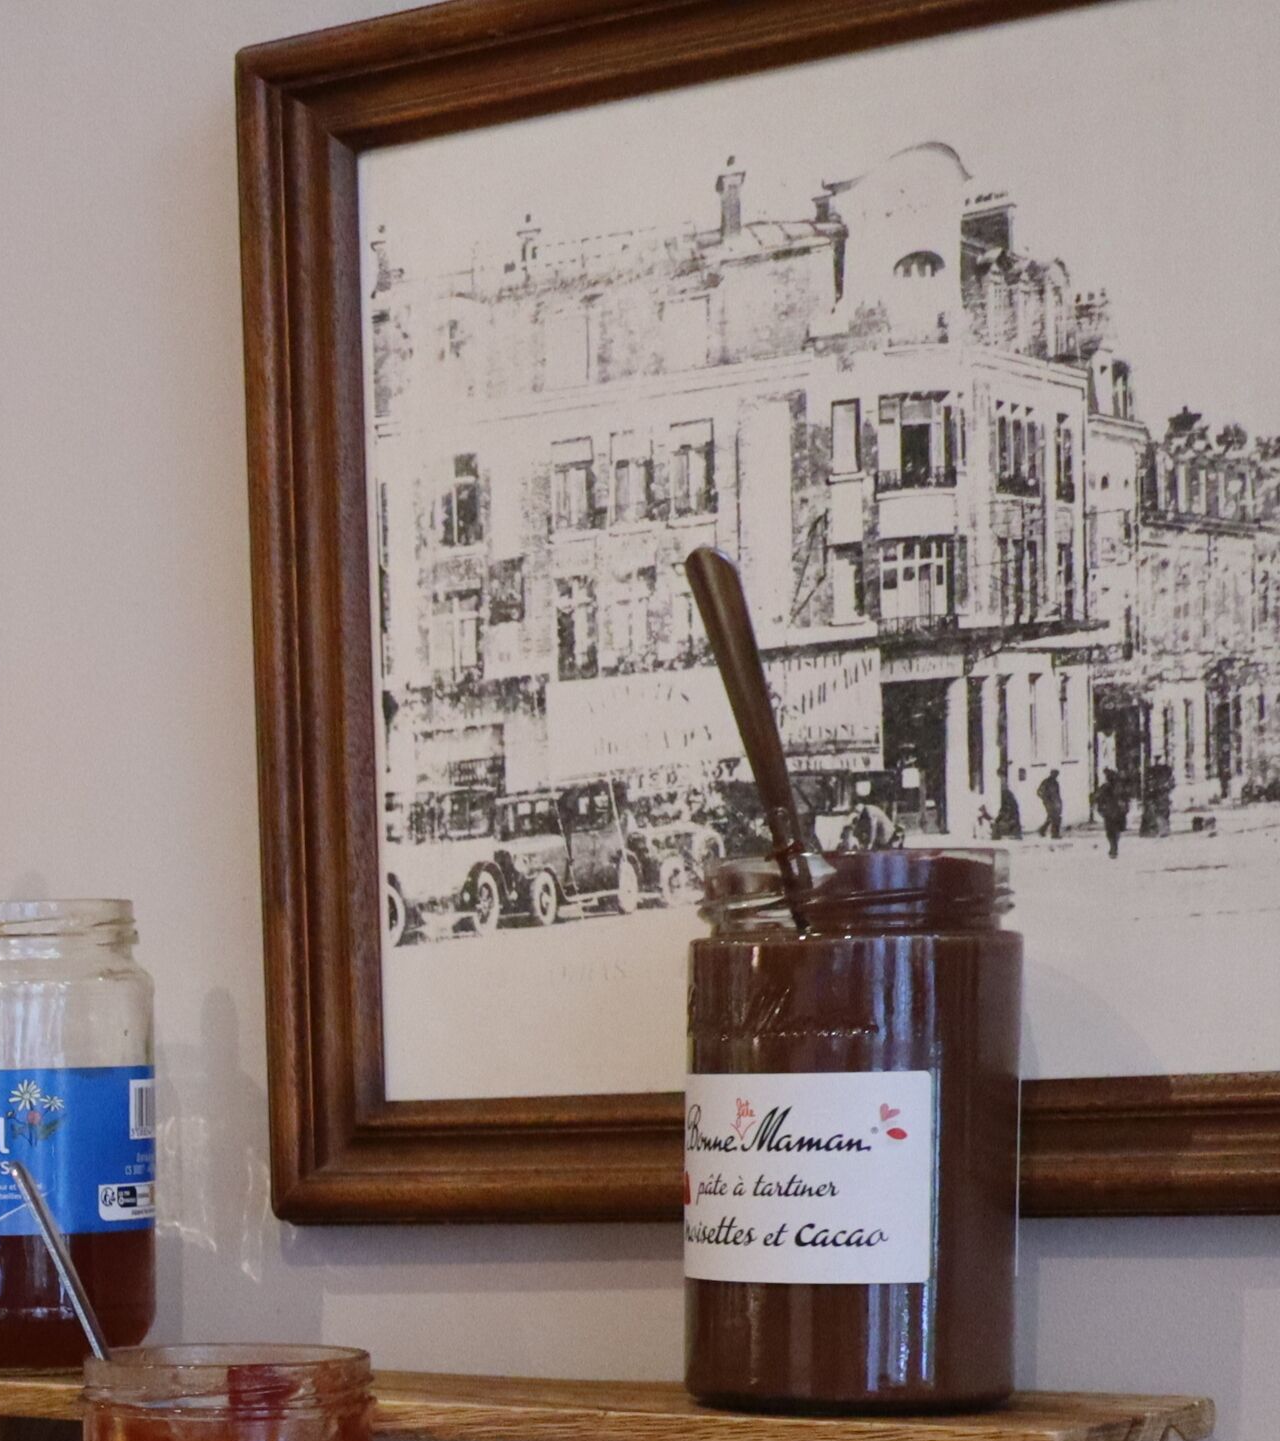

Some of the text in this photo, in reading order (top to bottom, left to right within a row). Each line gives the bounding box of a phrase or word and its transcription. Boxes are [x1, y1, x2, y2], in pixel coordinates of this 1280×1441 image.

[687, 1104, 737, 1151] Bonne
[696, 1173, 840, 1205] pâte à tartiner
[763, 1223, 787, 1246] et
[794, 1223, 888, 1247] Cacao
